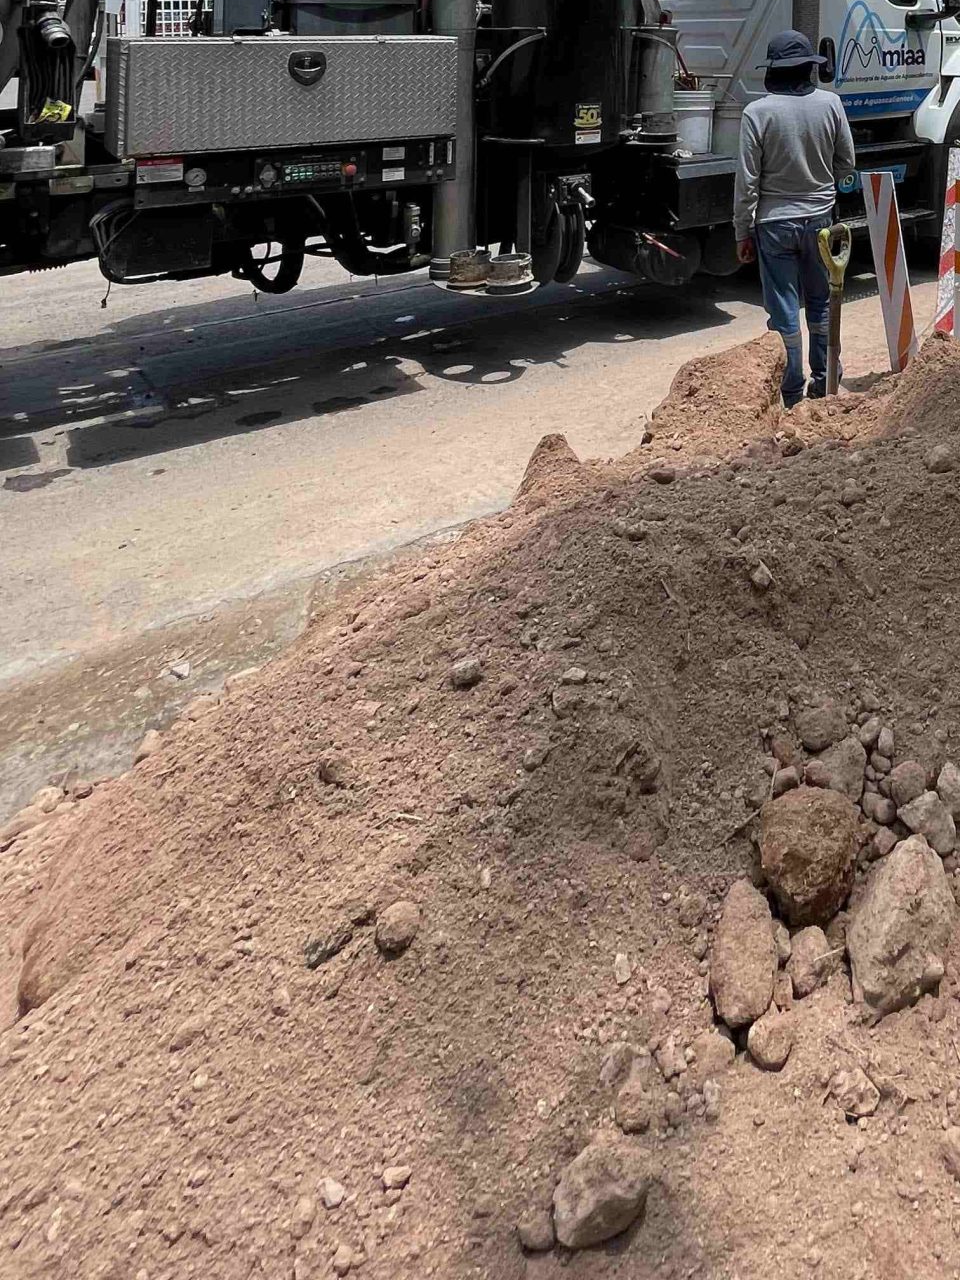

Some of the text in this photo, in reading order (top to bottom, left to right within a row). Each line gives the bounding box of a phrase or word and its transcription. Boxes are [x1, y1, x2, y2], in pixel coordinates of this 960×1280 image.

[882, 43, 926, 67] miaa
[853, 98, 863, 107] de
[864, 95, 914, 108] Aguascalientes
[579, 109, 598, 121] 50
